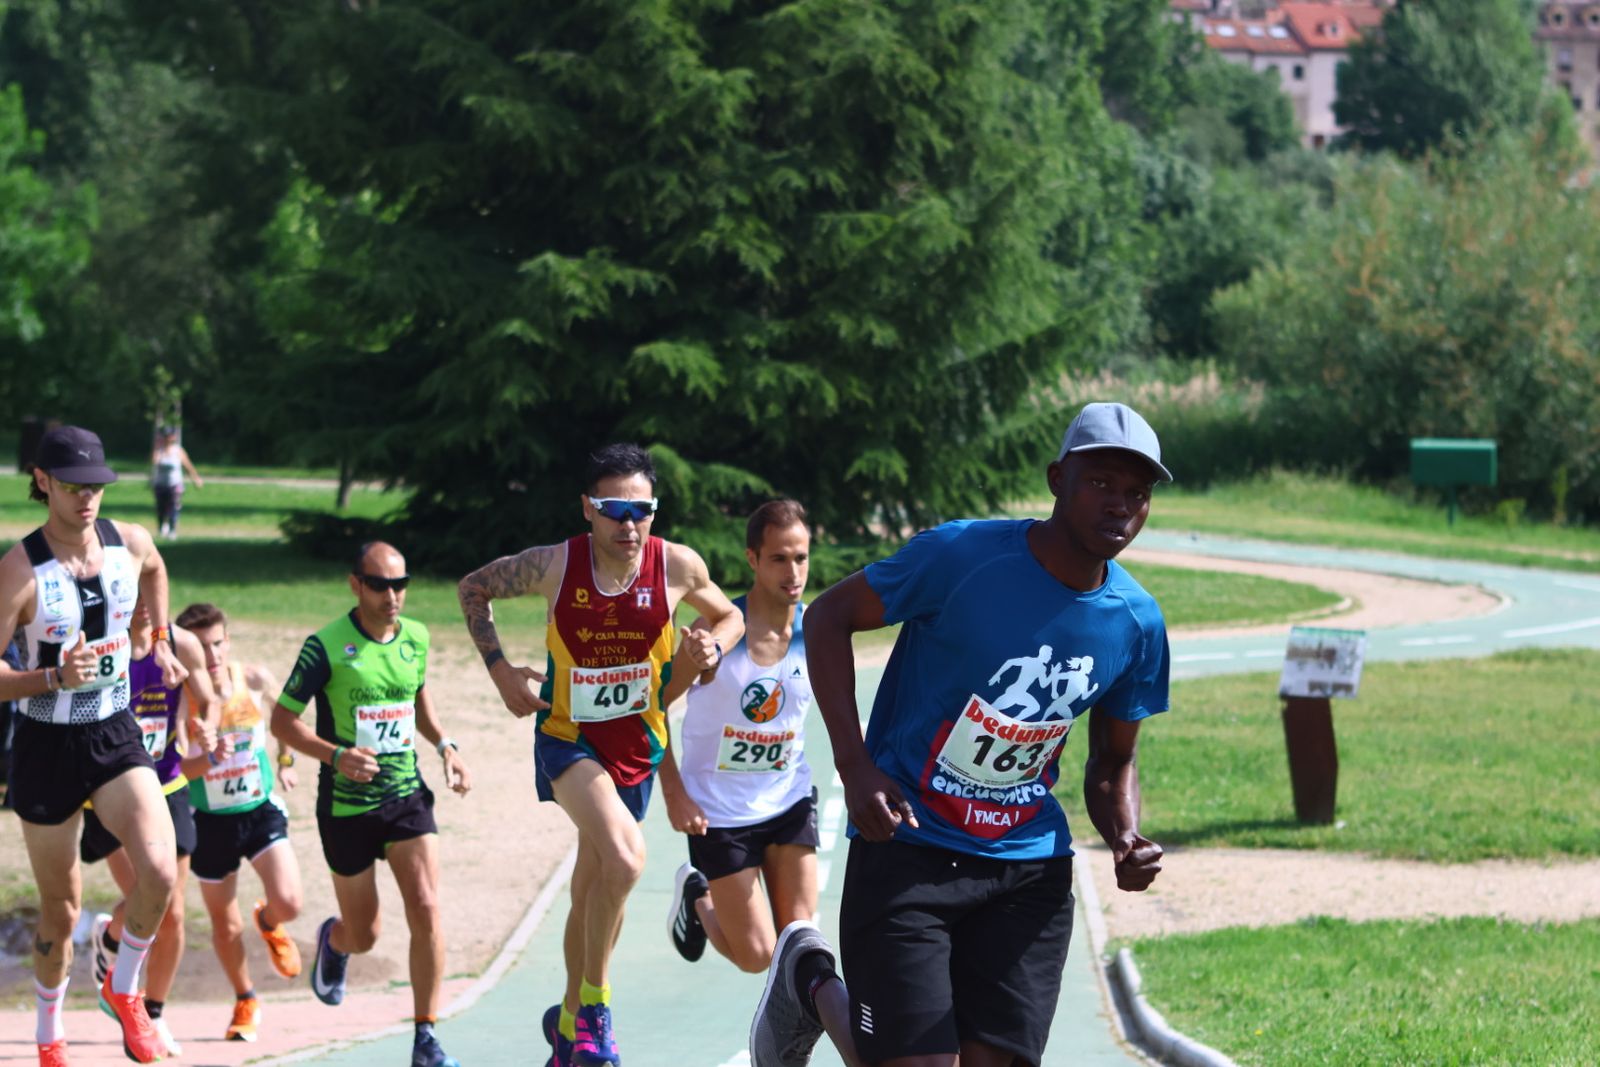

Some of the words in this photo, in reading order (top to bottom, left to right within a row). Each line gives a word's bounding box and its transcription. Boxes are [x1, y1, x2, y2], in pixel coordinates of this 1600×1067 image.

[618, 631, 646, 640] RURAL
[594, 645, 627, 655] VINO
[96, 655, 114, 677] 8
[582, 657, 599, 667] DE
[601, 656, 637, 665] TORO
[573, 667, 650, 685] bedunia
[594, 683, 629, 708] 40
[358, 706, 414, 720] bedunia
[965, 699, 1067, 743] bedunia
[375, 721, 400, 741] 74
[723, 725, 795, 744] bedunia
[146, 733, 157, 752] 7
[730, 741, 782, 763] 290
[972, 734, 1045, 772] 163
[205, 763, 258, 780] bedunia
[224, 776, 248, 795] 44
[932, 775, 1046, 805] encuentro
[974, 810, 1012, 827] YMCA
